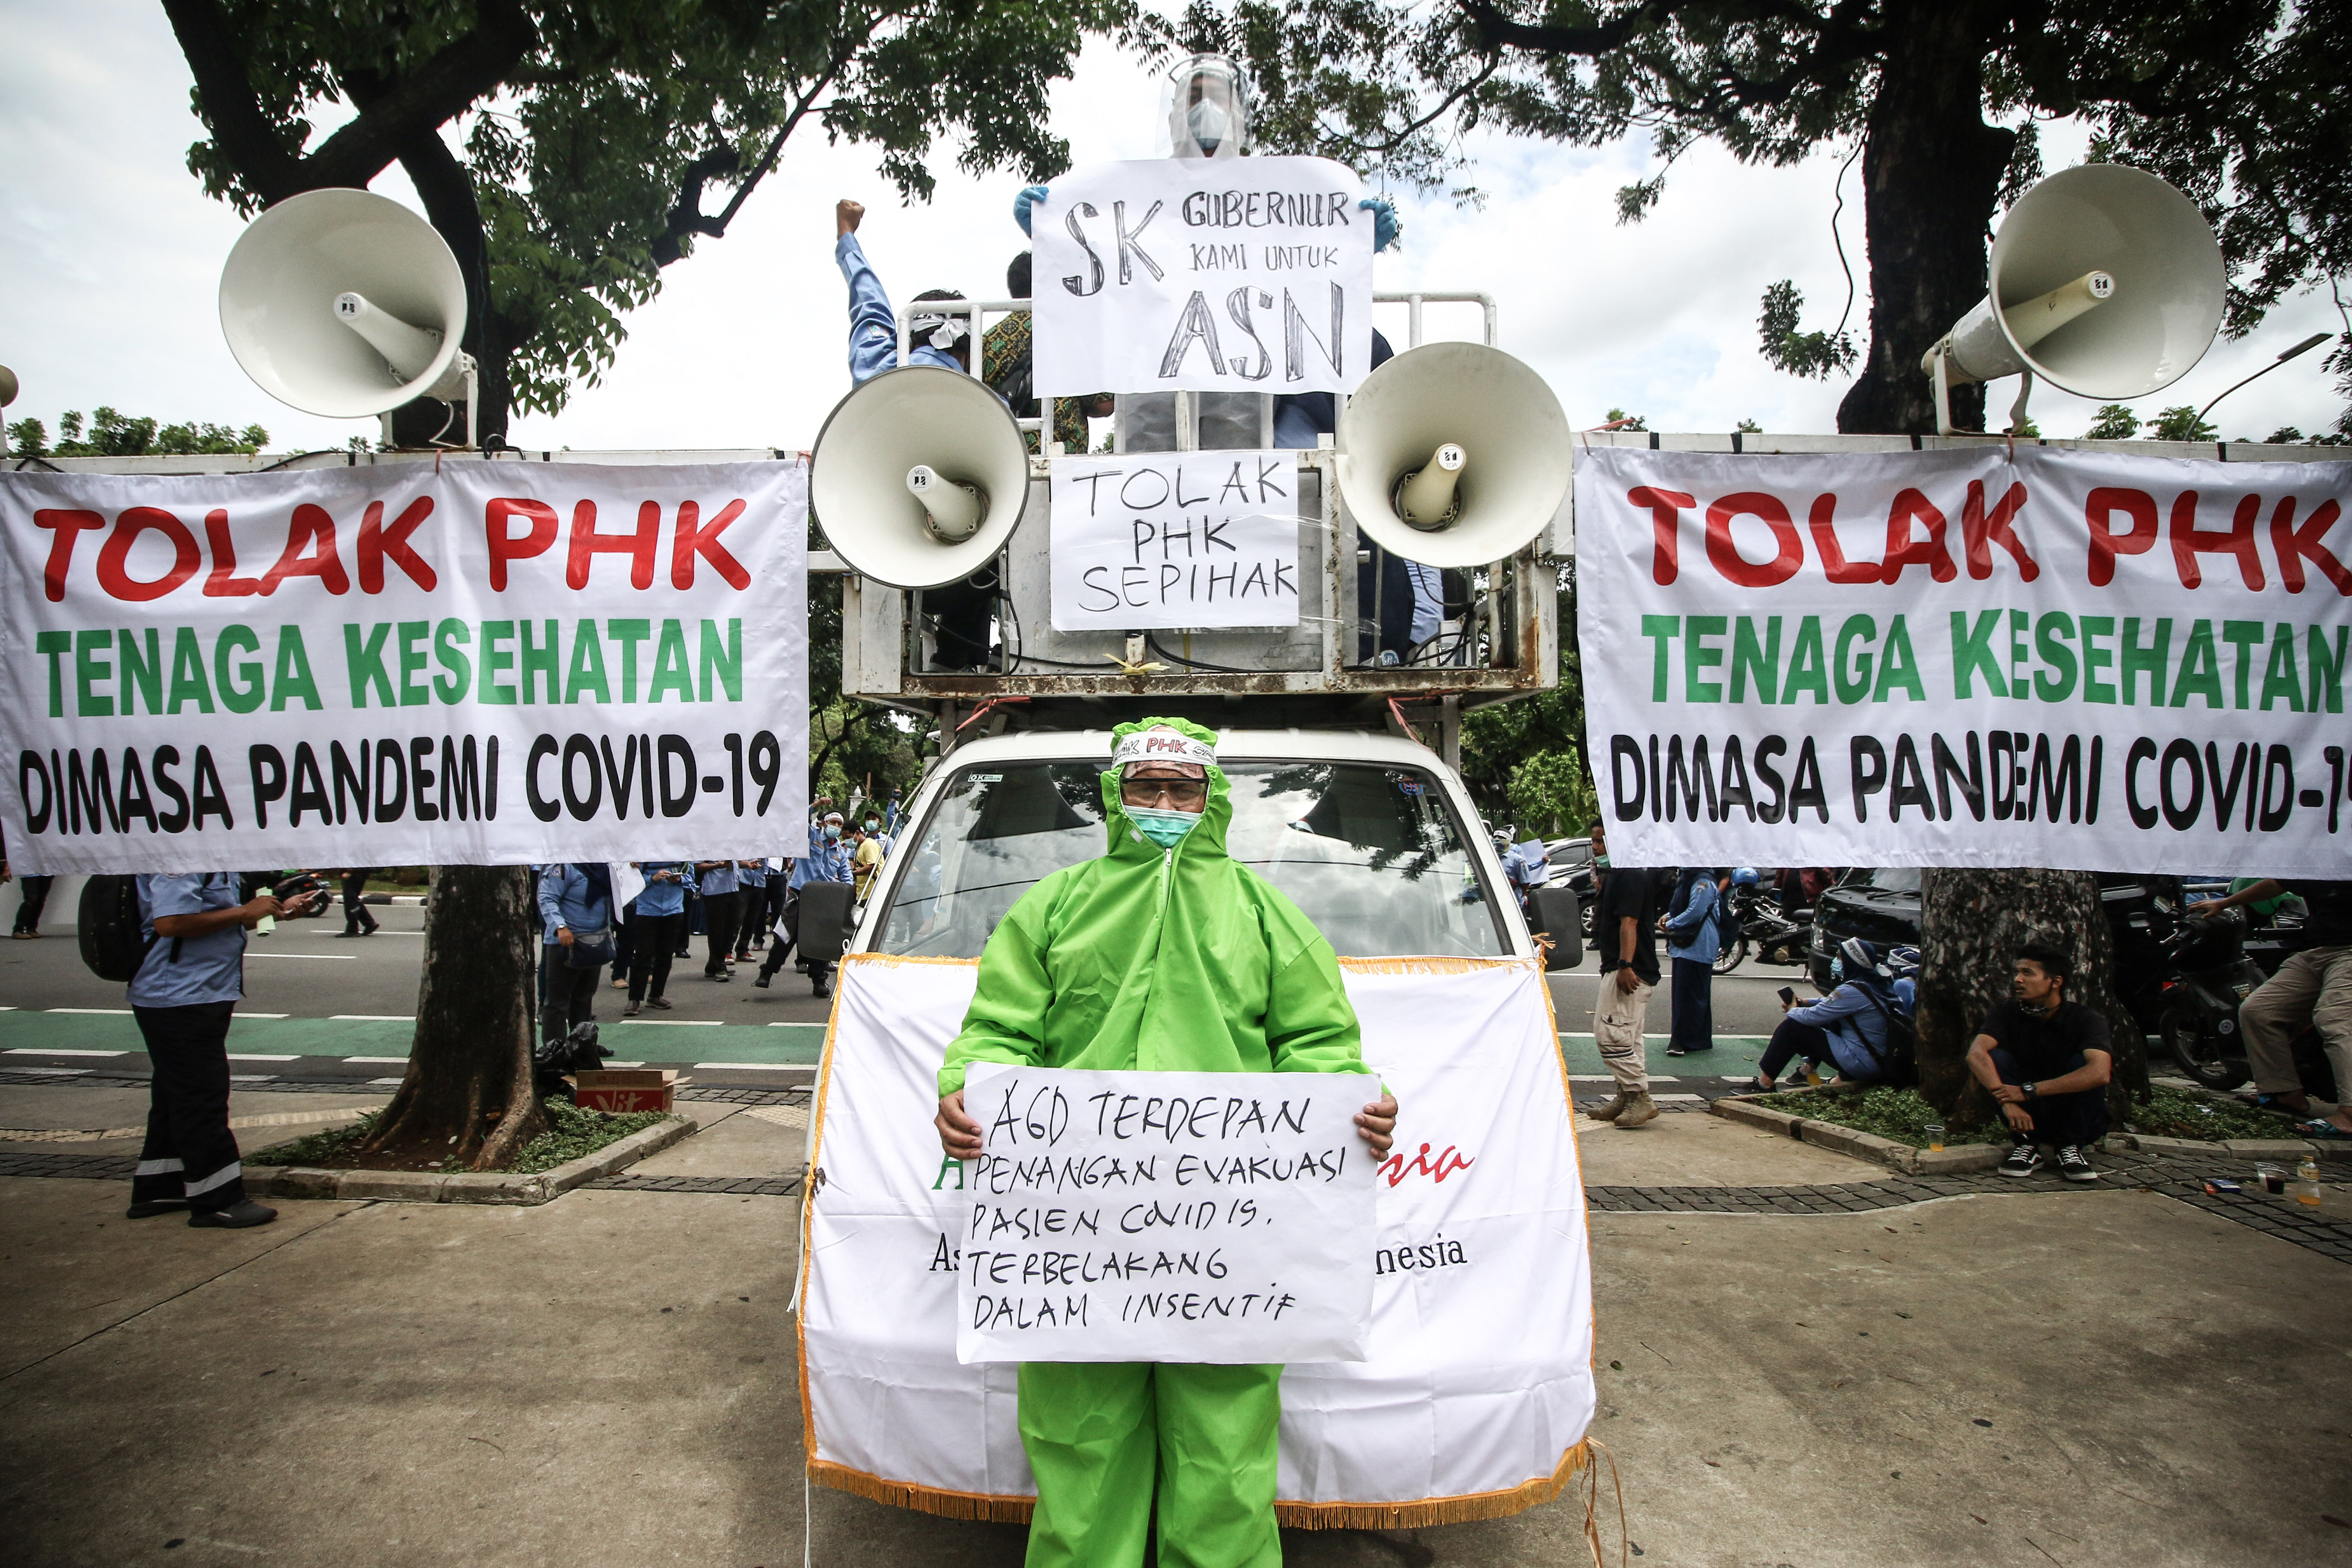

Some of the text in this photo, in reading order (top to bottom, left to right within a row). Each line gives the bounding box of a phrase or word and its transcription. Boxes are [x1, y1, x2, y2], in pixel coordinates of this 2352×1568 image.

[1182, 190, 1349, 228] GUBERNUR
[1062, 200, 1164, 297] SK
[1189, 244, 1338, 271] KAMI UNTUK
[1157, 280, 1344, 382] ASN
[1071, 455, 1287, 518] TOLAK
[34, 496, 751, 602] TOLAK PHK
[1132, 515, 1237, 564] PHK
[1628, 480, 2352, 596] TOLAK PHK
[1078, 558, 1298, 612] SEPIHAK
[37, 618, 742, 717] TENAGA KESEHATAN
[1642, 609, 2349, 713] TENAGA KESEHATAN
[1146, 737, 1188, 754] PHK
[20, 731, 780, 835] DIMASA PANDEMI COVID-19
[1611, 731, 2352, 834] DIMASA PANDEMI COVID-1
[989, 1079, 1310, 1147] AGD TERDEPAN
[973, 1153, 1156, 1195] PENANGAN
[1176, 1147, 1346, 1186] EVAKUASI
[972, 1203, 1100, 1241] PASIEN
[968, 1248, 1228, 1287] TERBELAKANG
[1376, 1233, 1468, 1275] nesia
[974, 1293, 1087, 1330] DALAM
